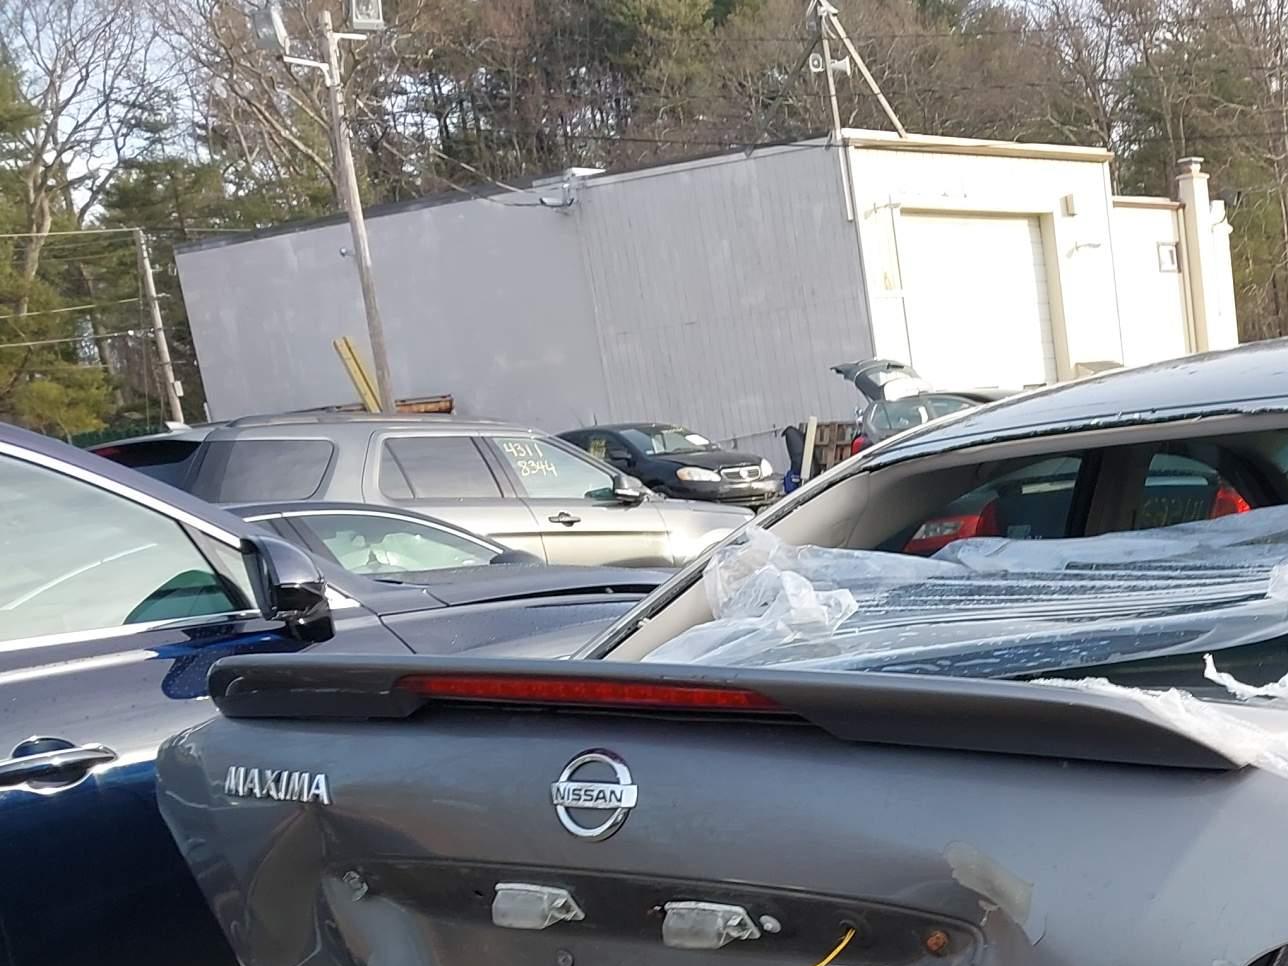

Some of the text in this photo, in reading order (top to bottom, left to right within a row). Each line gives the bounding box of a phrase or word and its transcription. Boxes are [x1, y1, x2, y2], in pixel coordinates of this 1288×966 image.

[503, 442, 543, 457] 4311
[517, 460, 558, 477] 8344
[224, 766, 331, 805] MAXIMA
[555, 787, 624, 803] NISSAN
